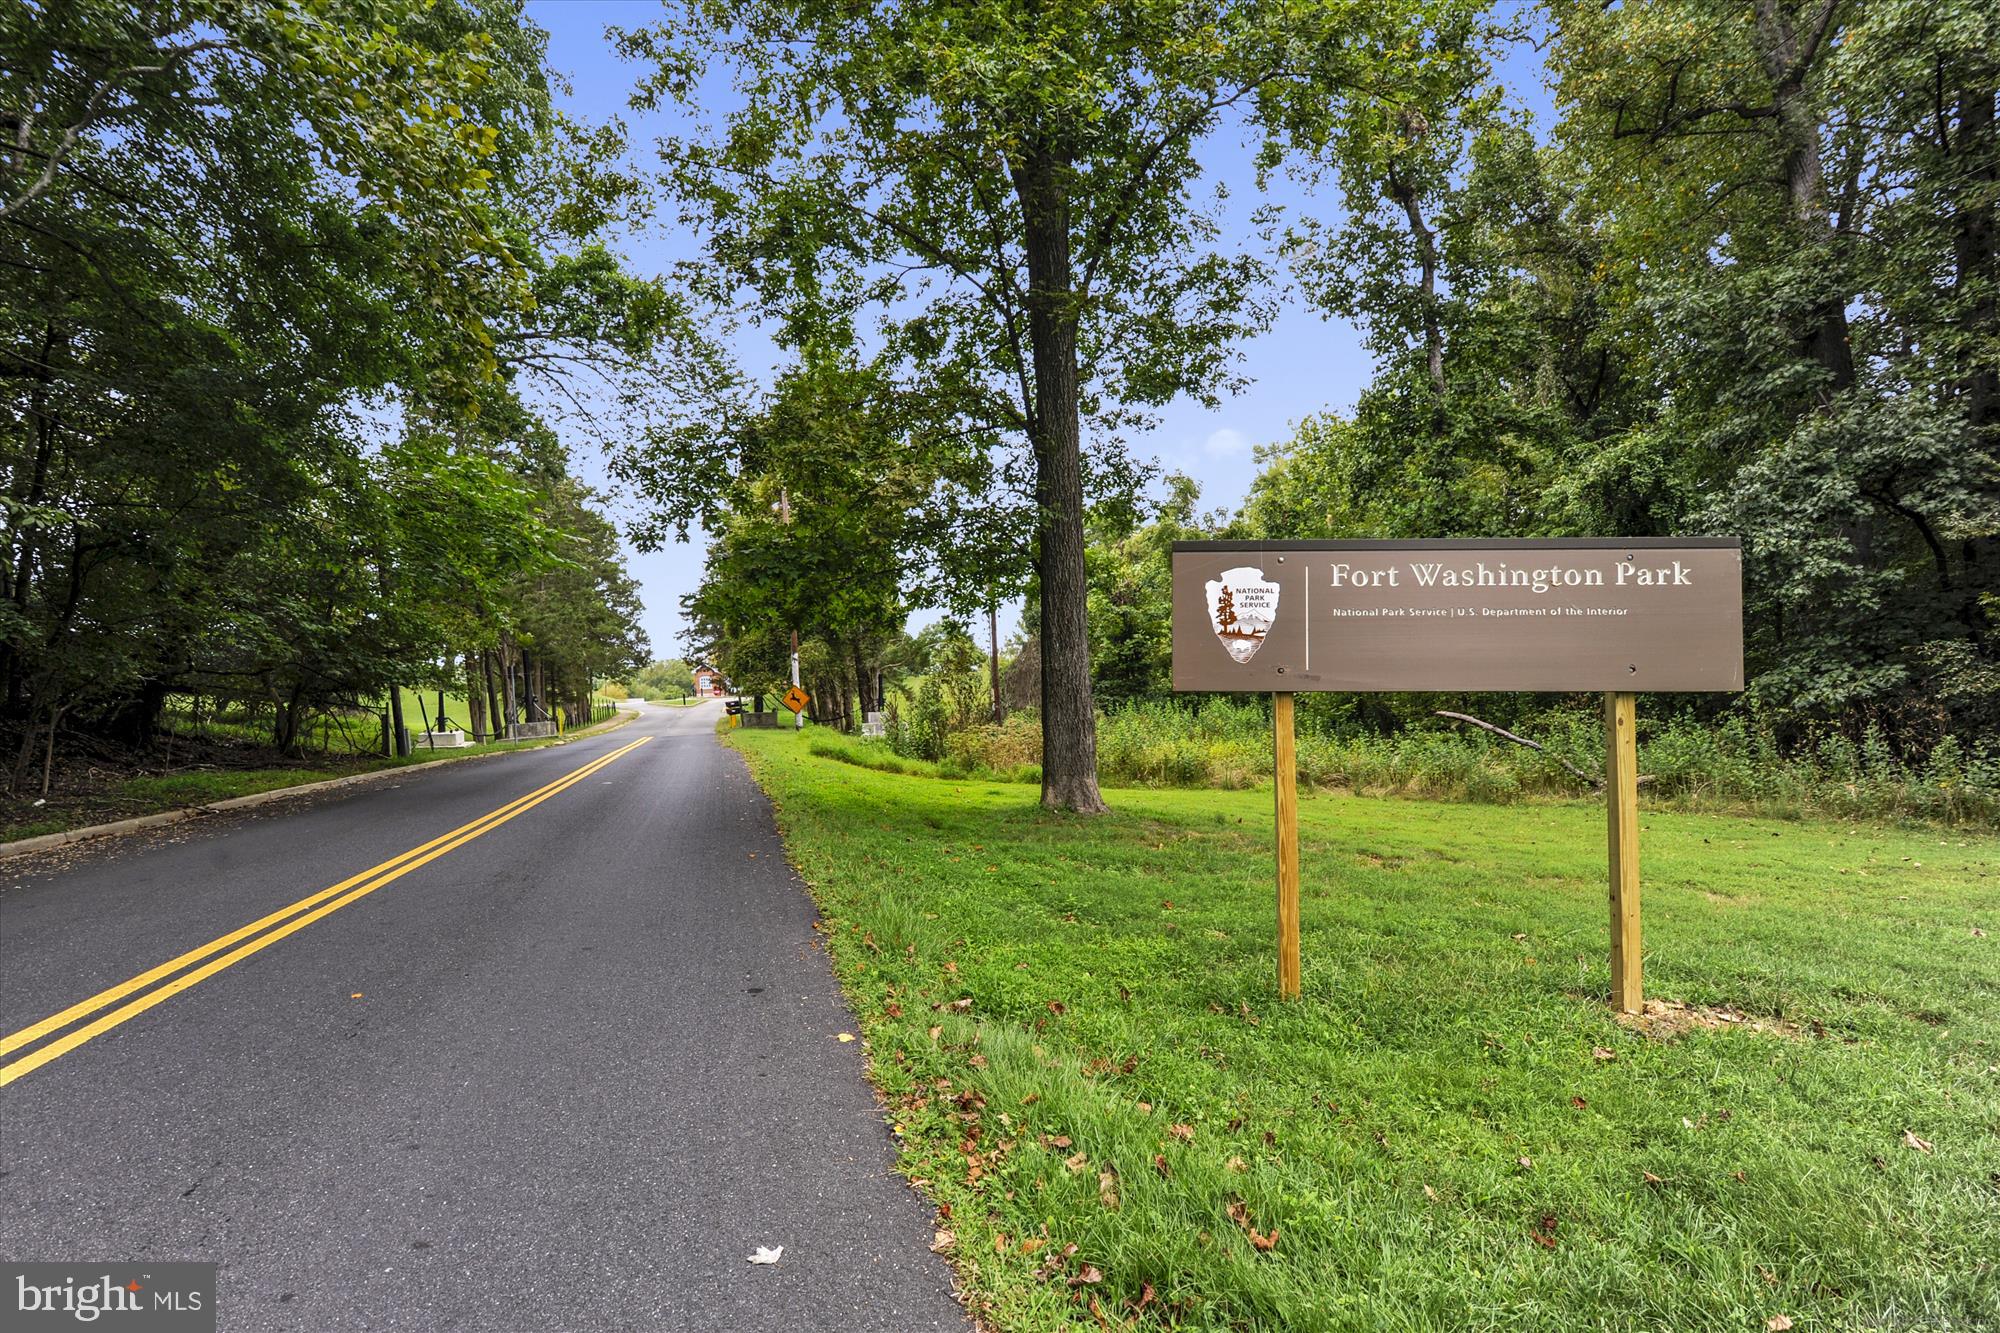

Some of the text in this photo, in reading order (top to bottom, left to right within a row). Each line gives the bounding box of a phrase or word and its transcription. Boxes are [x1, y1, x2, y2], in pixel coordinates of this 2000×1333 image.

[1330, 560, 1692, 593] Fort Washington Park
[1333, 607, 1628, 618] National Park Service U.S. Department of the Interior
